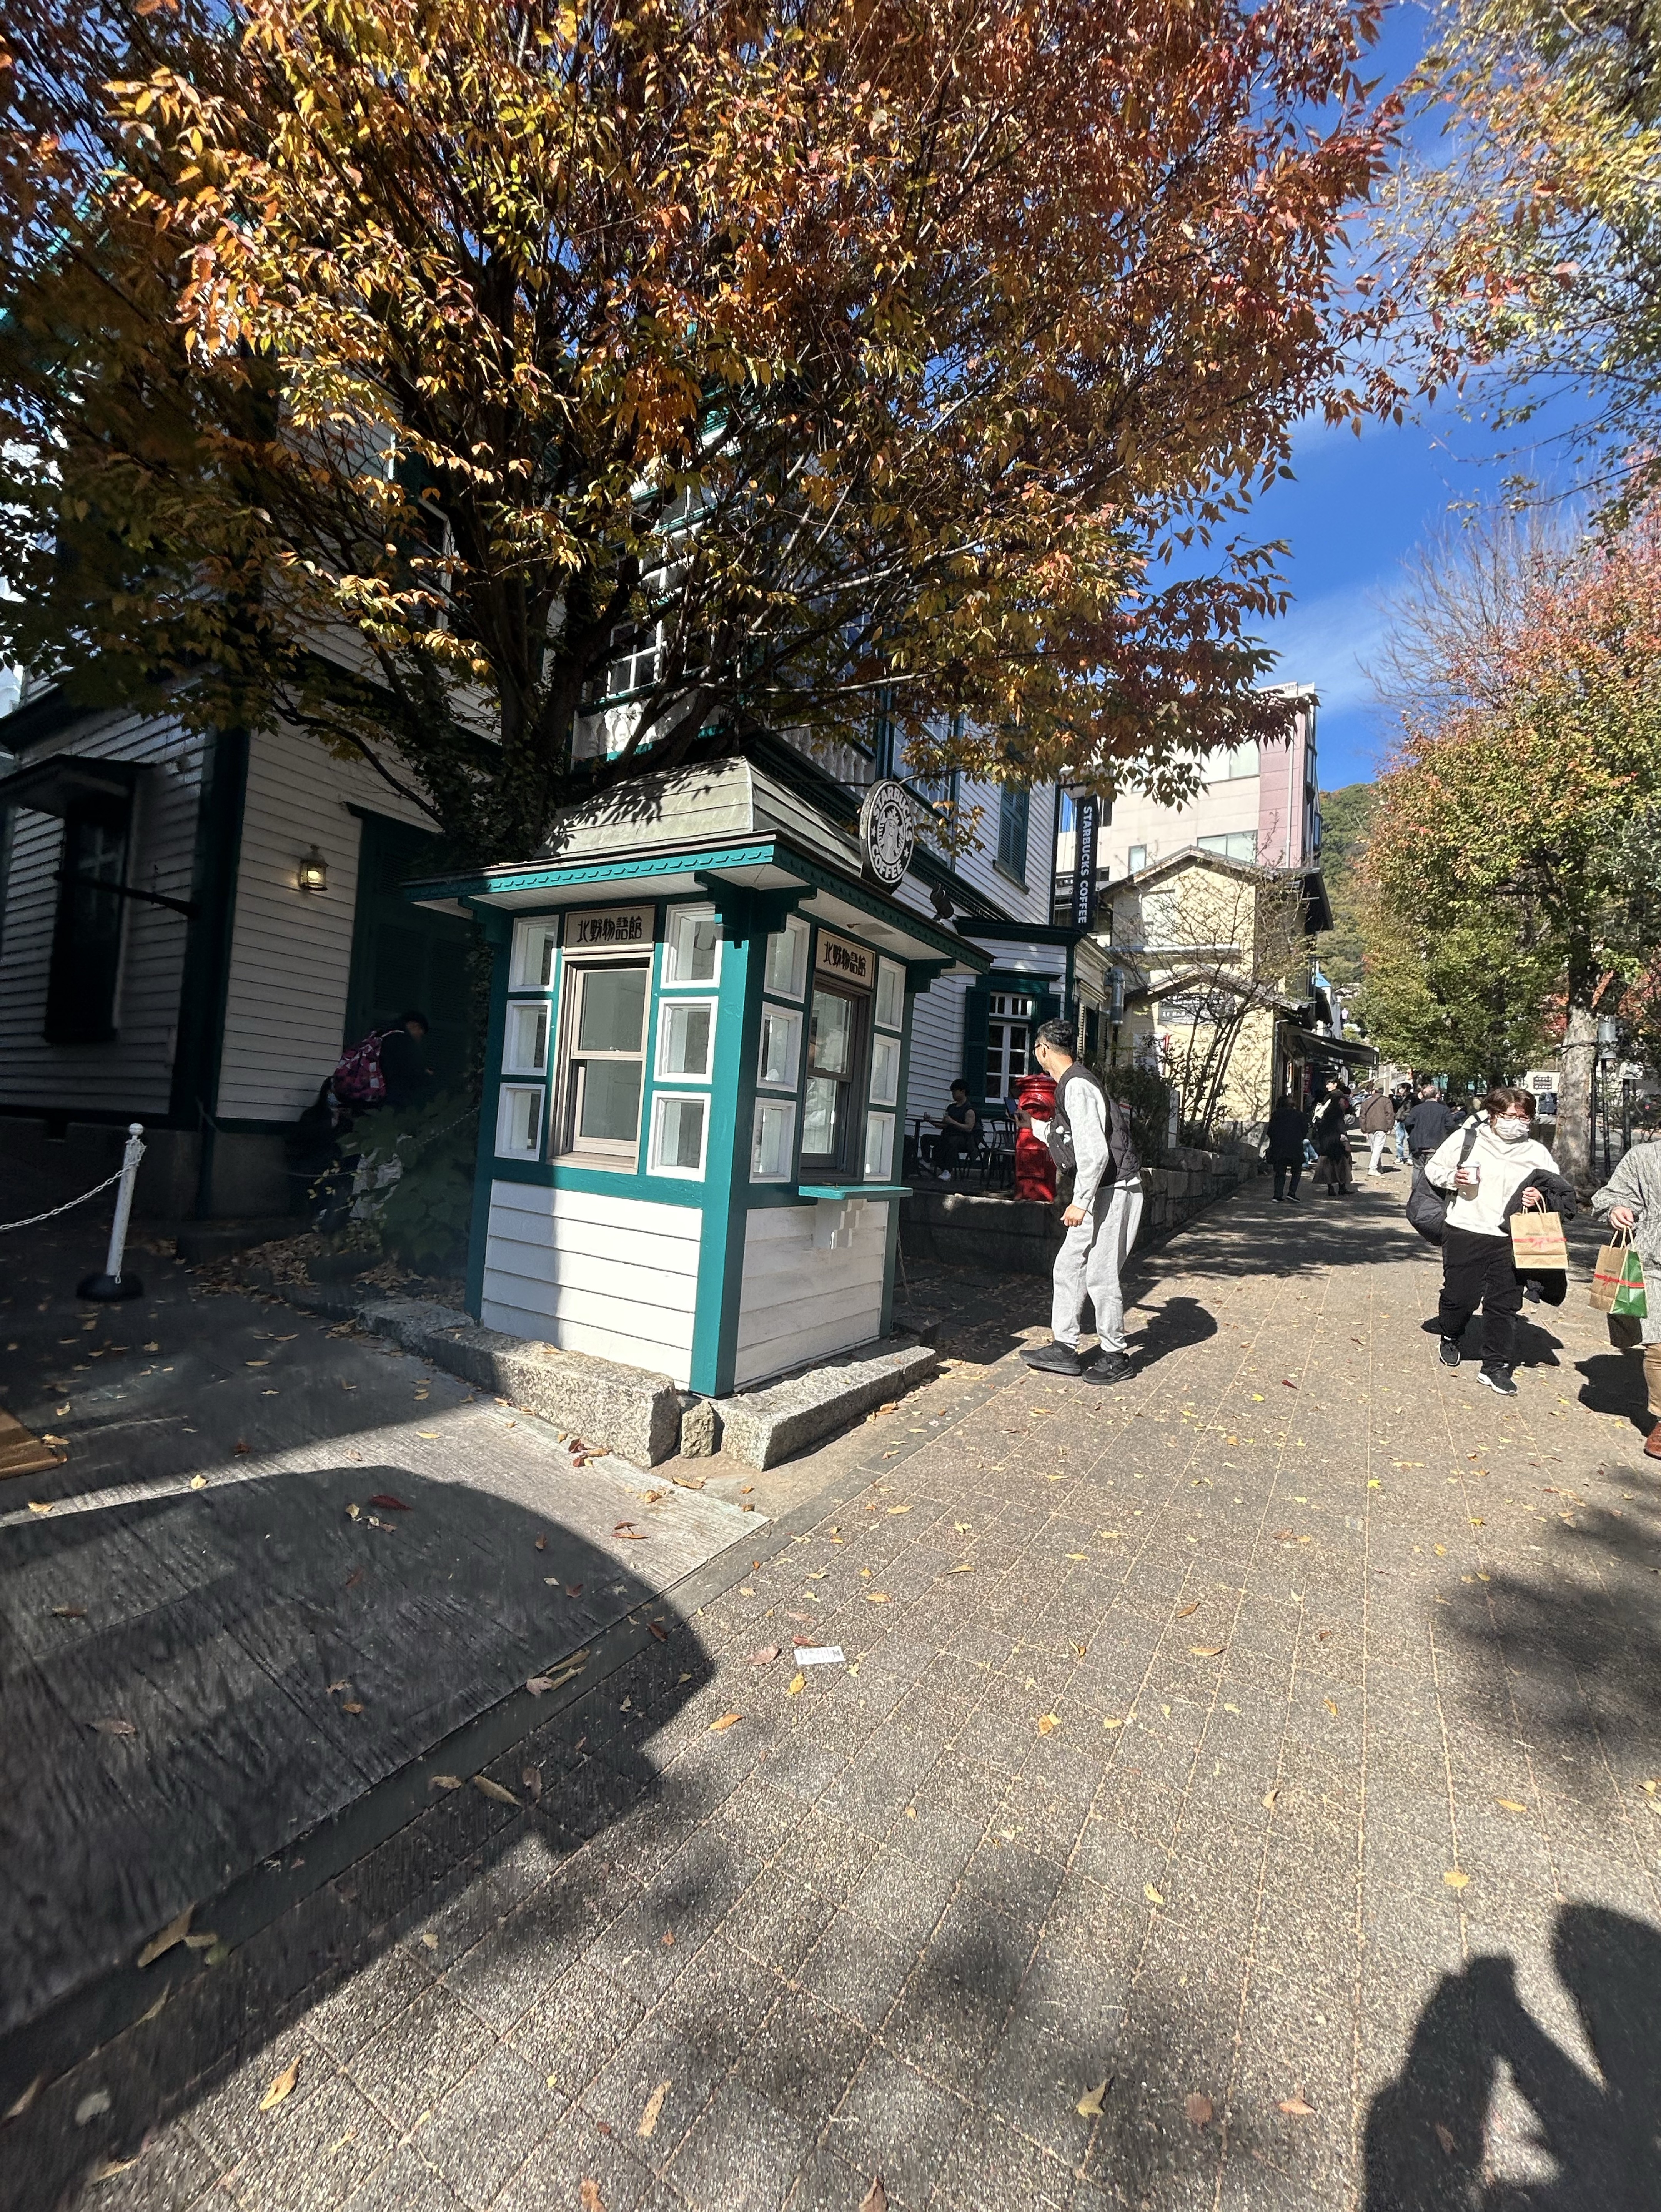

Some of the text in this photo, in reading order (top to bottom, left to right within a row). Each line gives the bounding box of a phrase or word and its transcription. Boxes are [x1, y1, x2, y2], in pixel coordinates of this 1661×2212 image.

[873, 786, 912, 841] STARBUCKS
[871, 844, 903, 878] COFFEE
[1078, 806, 1093, 923] STARBUCKS COFFEE
[577, 916, 642, 943] 北野物語館
[823, 941, 867, 977] 北野物語館
